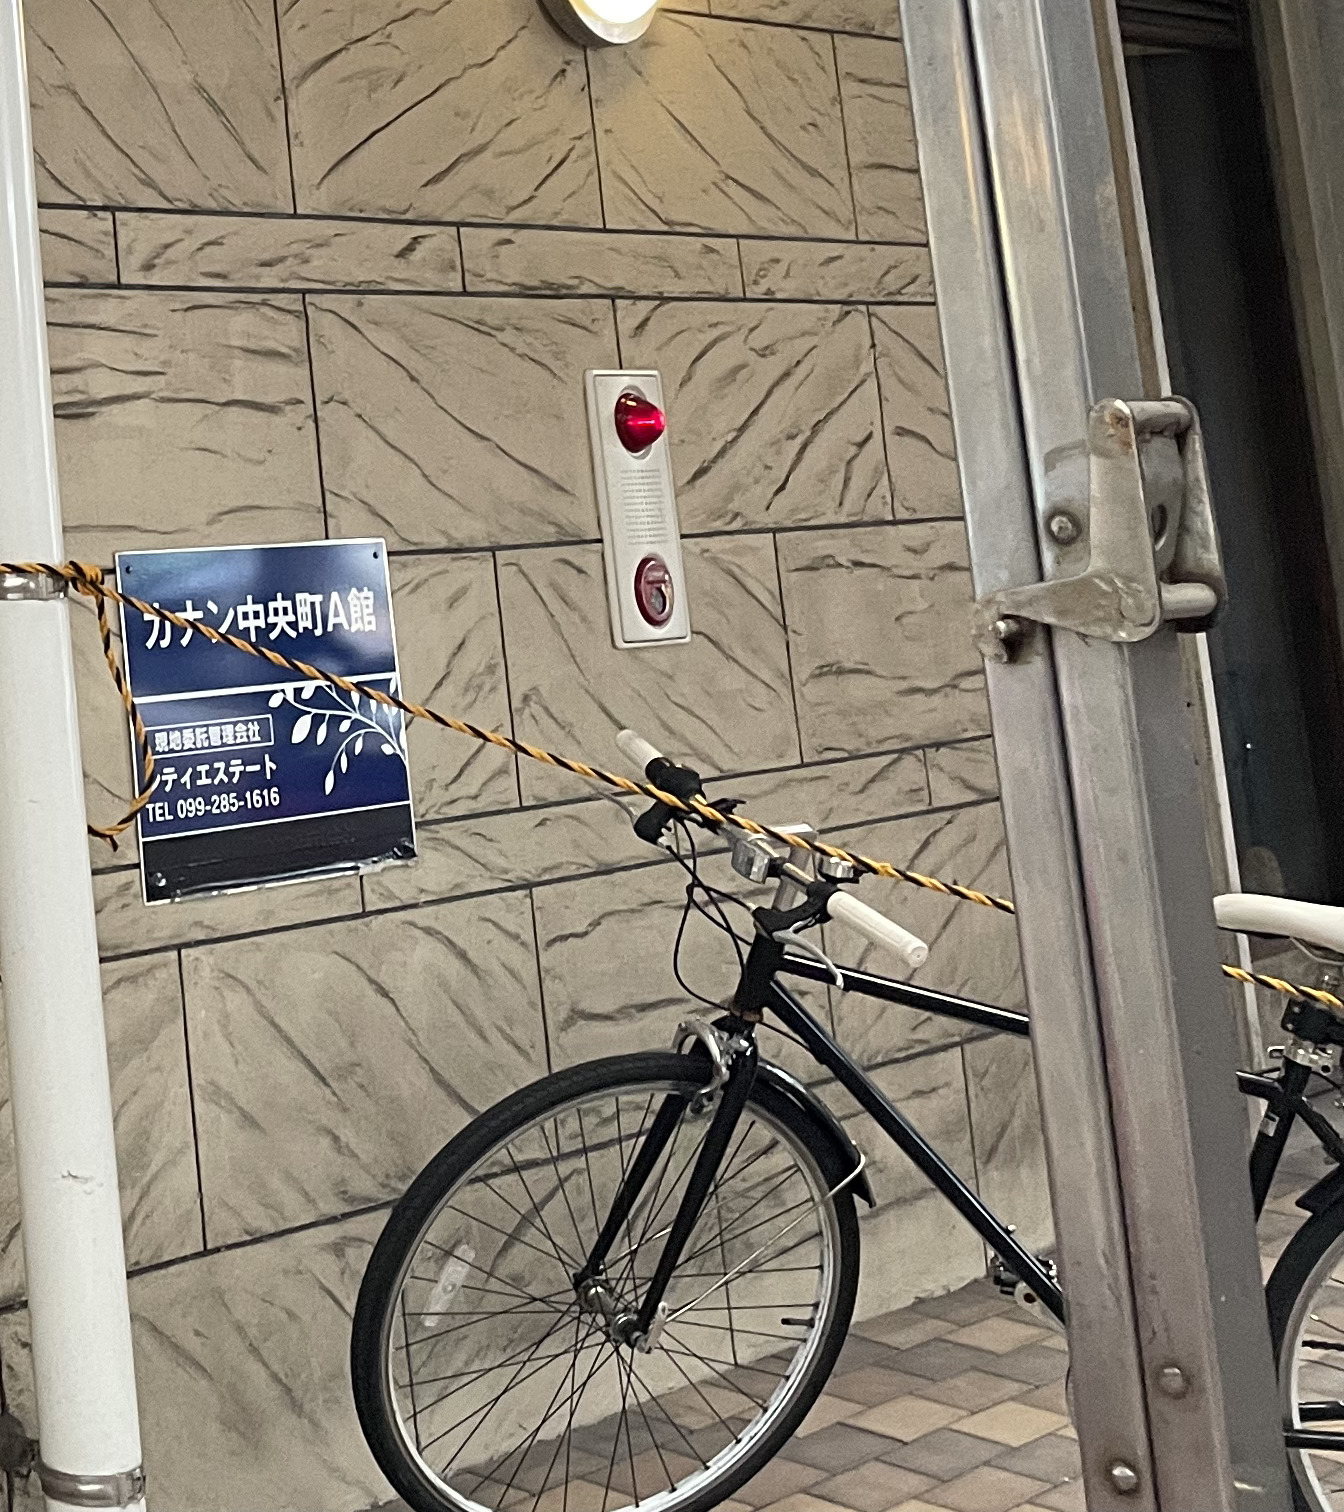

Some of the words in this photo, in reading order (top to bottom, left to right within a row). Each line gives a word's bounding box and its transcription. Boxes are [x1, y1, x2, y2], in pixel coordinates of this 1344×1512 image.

[143, 586, 377, 650] カナン中央町A館
[145, 801, 174, 823] TEL
[176, 786, 280, 819] 099-285-1616
